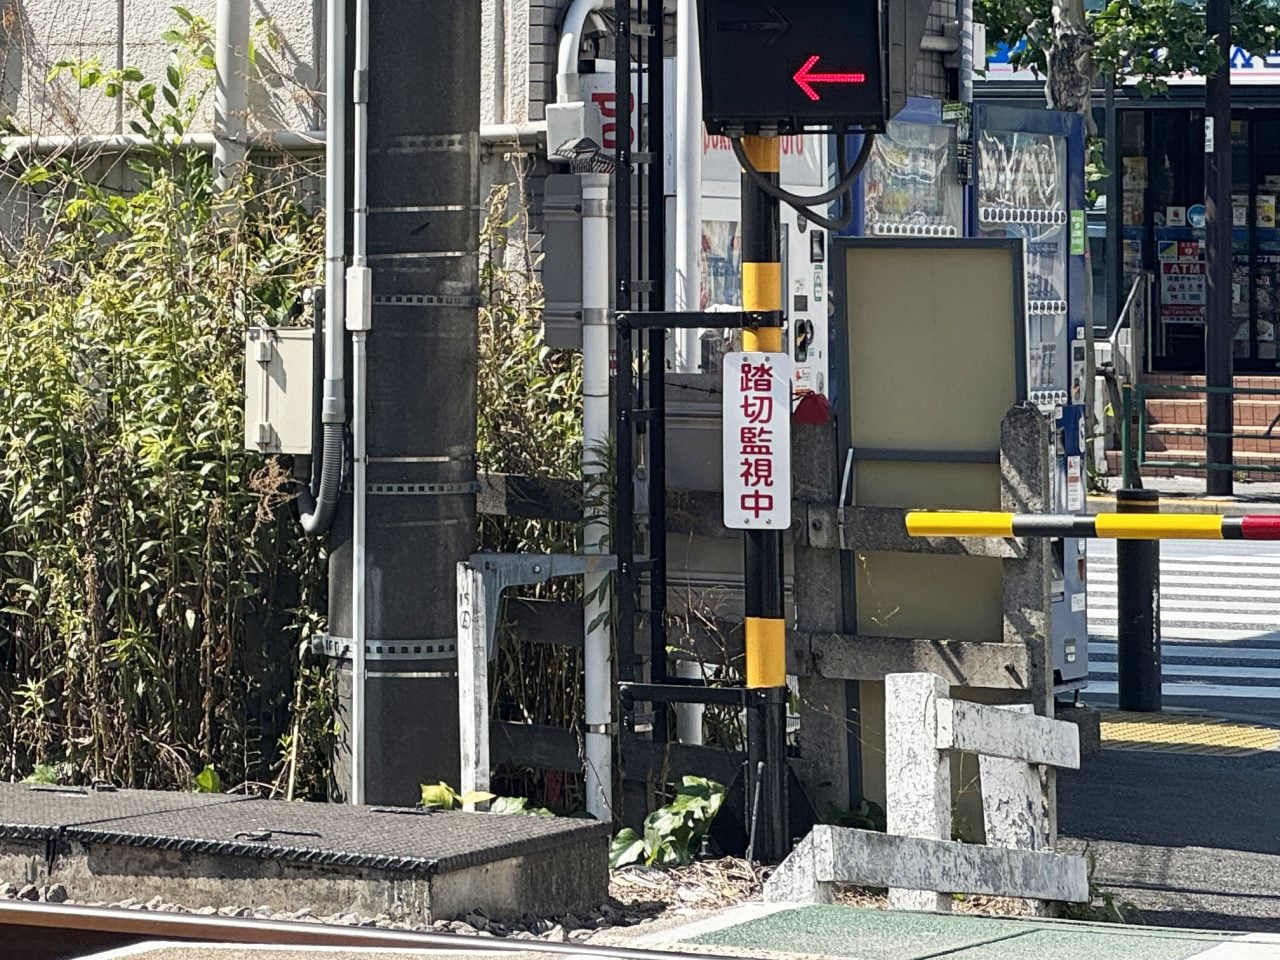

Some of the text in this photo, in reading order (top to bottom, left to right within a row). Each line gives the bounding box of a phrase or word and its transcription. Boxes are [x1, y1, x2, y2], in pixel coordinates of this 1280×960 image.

[1170, 264, 1200, 274] ATM
[740, 363, 773, 518] 踏切監視中
